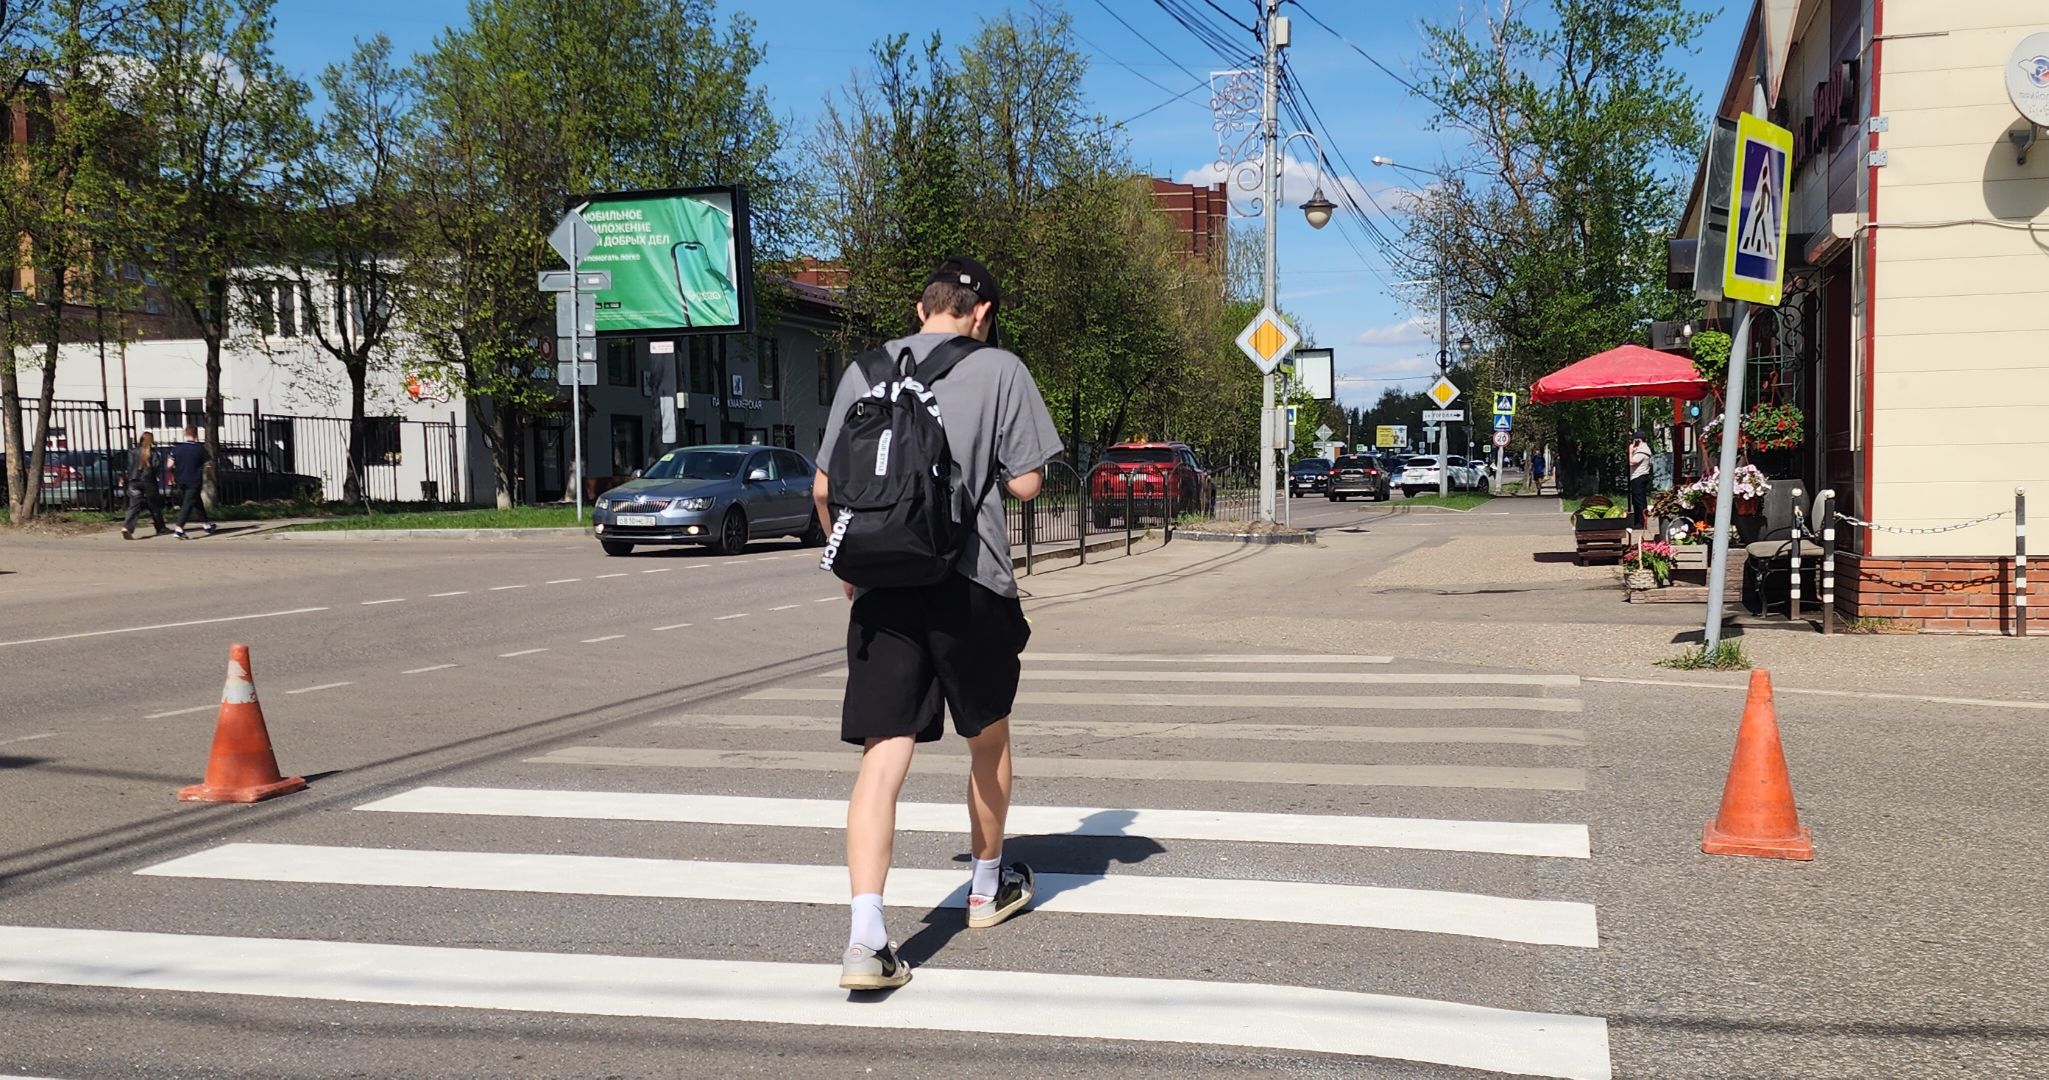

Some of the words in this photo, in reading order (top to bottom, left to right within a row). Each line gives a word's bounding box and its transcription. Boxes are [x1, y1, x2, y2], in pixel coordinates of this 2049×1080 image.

[590, 223, 652, 234] ИЛОЖЕНИЕ
[604, 234, 646, 247] ДОБРЫХ
[648, 234, 670, 245] ДЕЛ
[712, 396, 762, 409] ПАКМАХЕРСКАЯ
